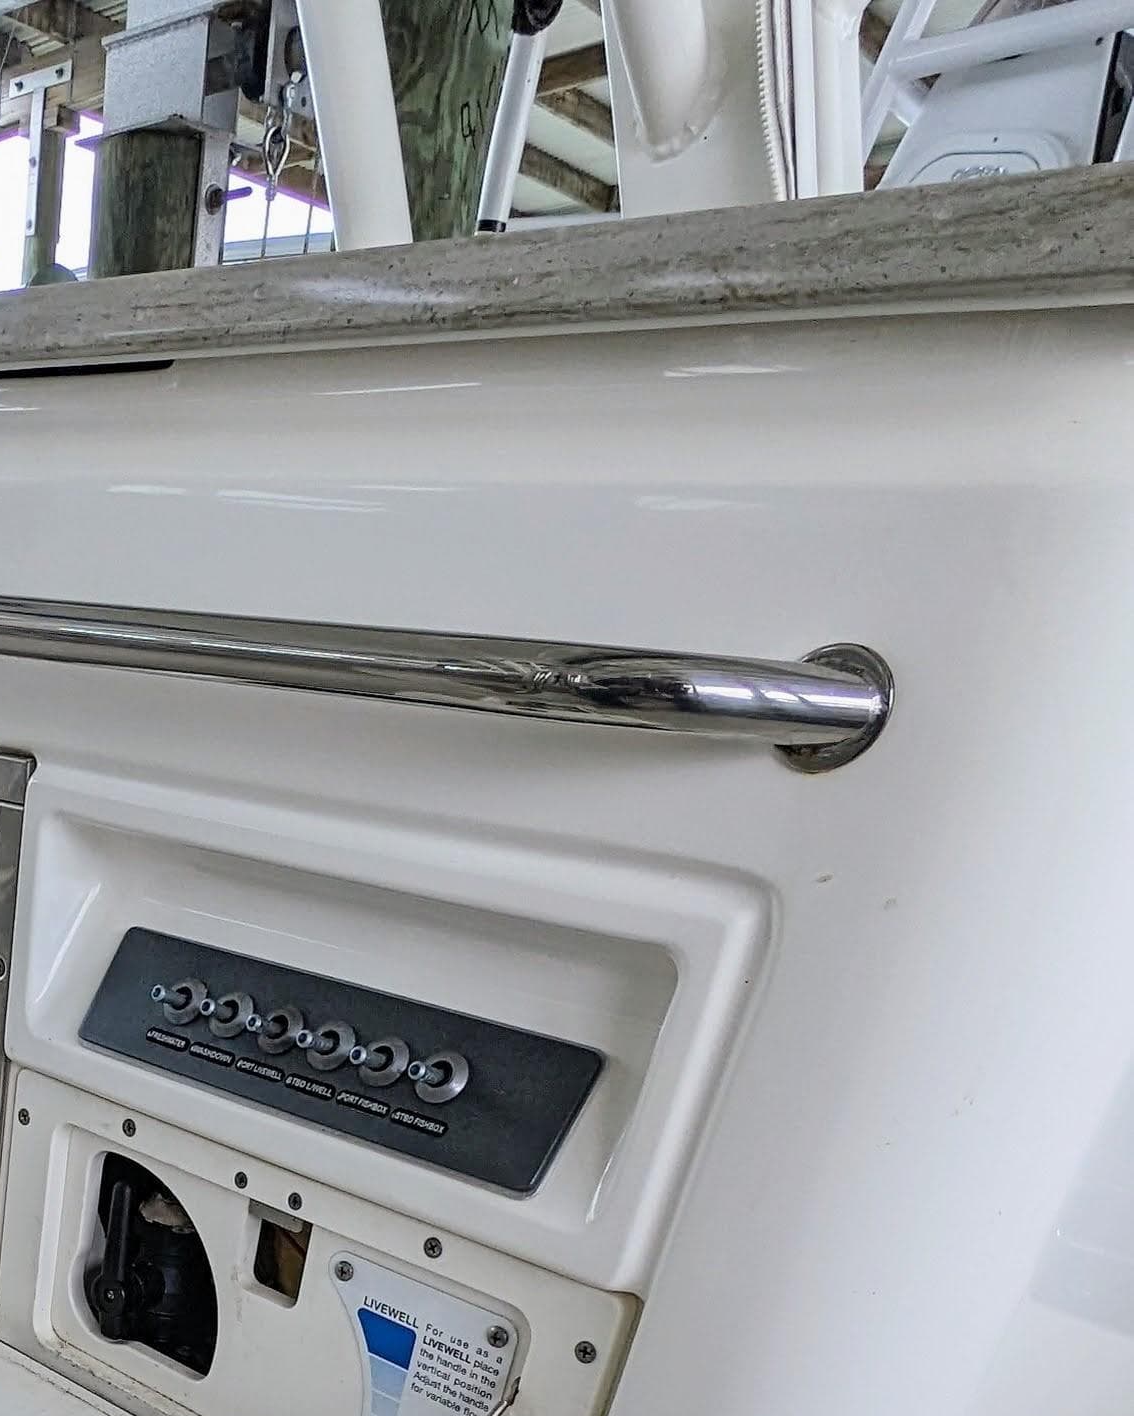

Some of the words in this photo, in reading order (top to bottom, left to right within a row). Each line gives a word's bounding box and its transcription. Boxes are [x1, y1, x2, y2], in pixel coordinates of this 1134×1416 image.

[340, 1092, 359, 1104] PORT
[358, 1098, 388, 1115] FISHBOX
[394, 1111, 414, 1124] STBD
[413, 1117, 446, 1134] FISHBOX
[363, 1295, 419, 1329] LIVEWELL
[422, 1335, 471, 1364] LIVEWELL
[473, 1359, 500, 1377] place
[425, 1323, 444, 1337] For
[450, 1335, 470, 1349] use
[476, 1347, 489, 1358] as
[496, 1356, 503, 1365] a
[417, 1361, 451, 1381] vertical
[453, 1378, 493, 1400] position
[419, 1348, 434, 1360] the
[436, 1355, 467, 1375] handle
[469, 1369, 478, 1380] in
[480, 1375, 496, 1388] the
[410, 1382, 424, 1394] for
[426, 1390, 460, 1412] variable
[413, 1371, 441, 1390] Adjust
[442, 1384, 457, 1397] the
[458, 1391, 489, 1412] handle
